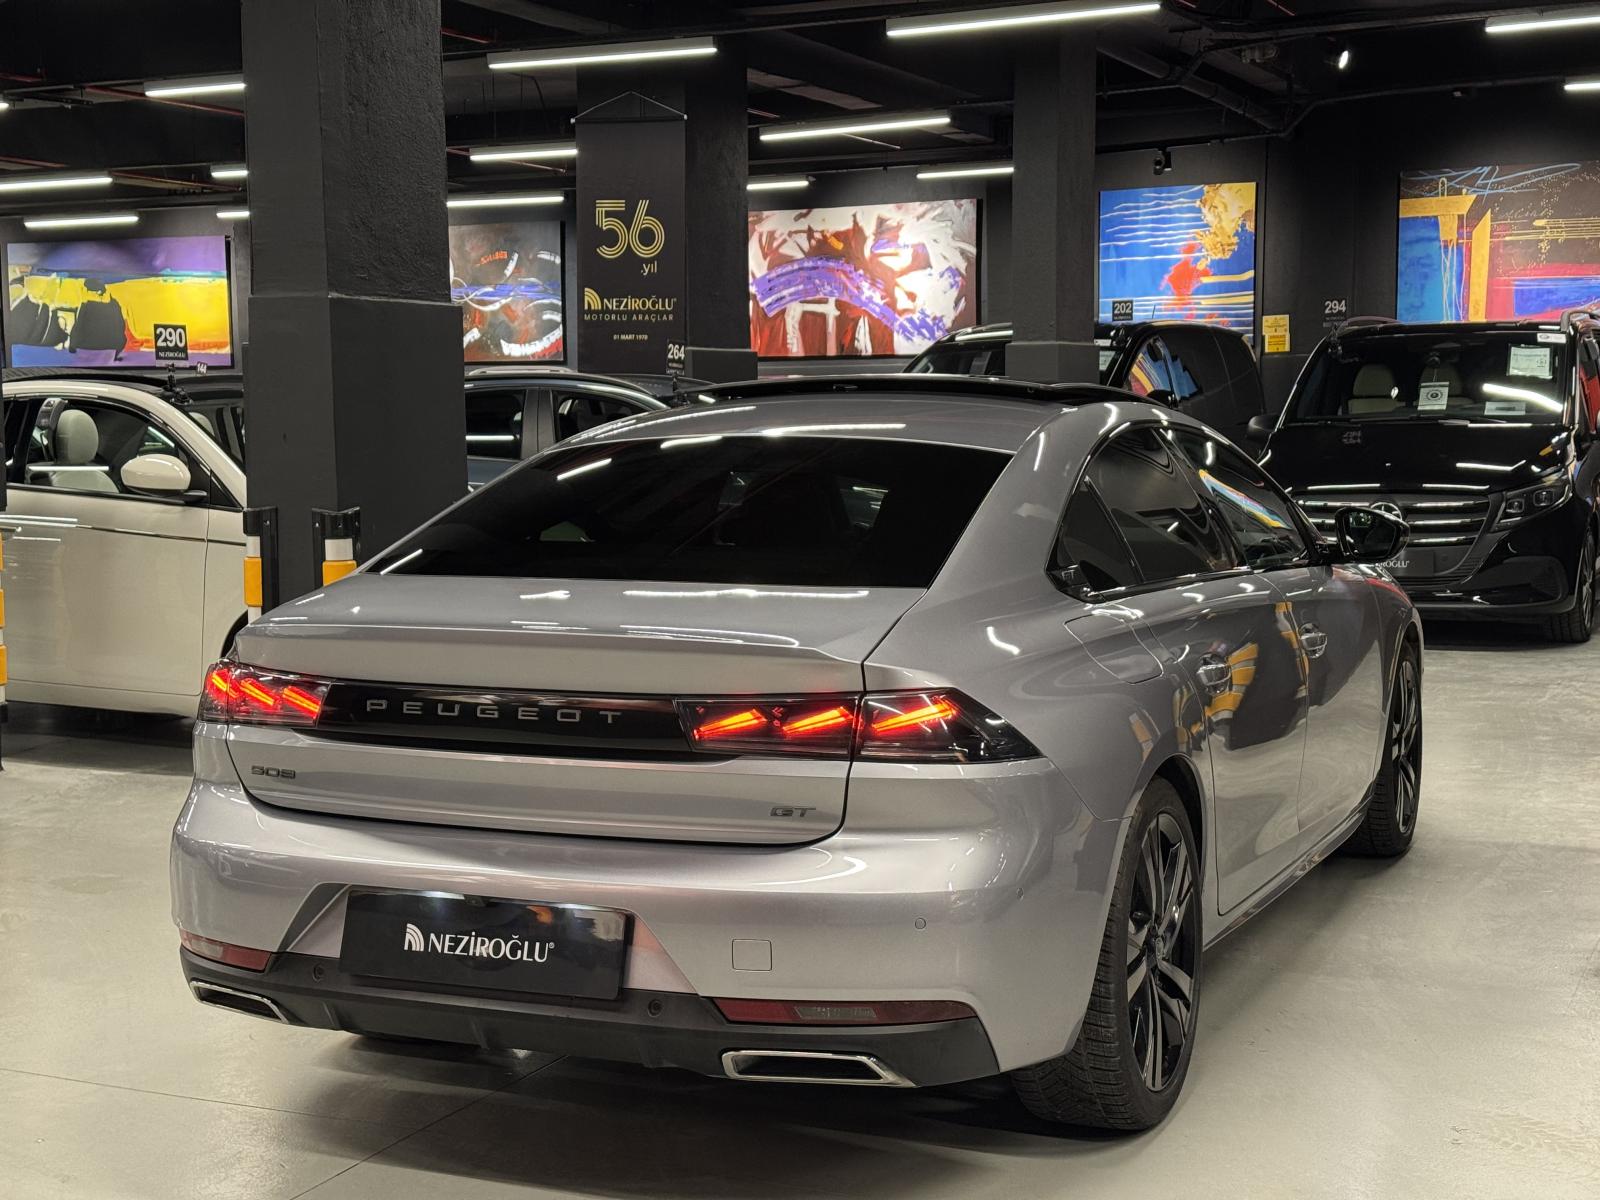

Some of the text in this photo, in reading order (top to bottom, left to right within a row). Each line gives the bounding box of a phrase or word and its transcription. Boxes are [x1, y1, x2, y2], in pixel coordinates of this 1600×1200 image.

[595, 199, 665, 259] 56
[1113, 302, 1132, 314] 202
[1324, 300, 1347, 314] 294
[584, 313, 674, 323] MOTORLU ARAÇLAR
[156, 327, 186, 348] 290
[667, 343, 685, 360] 264
[366, 699, 622, 724] PEUGEOT
[770, 807, 817, 818] GT
